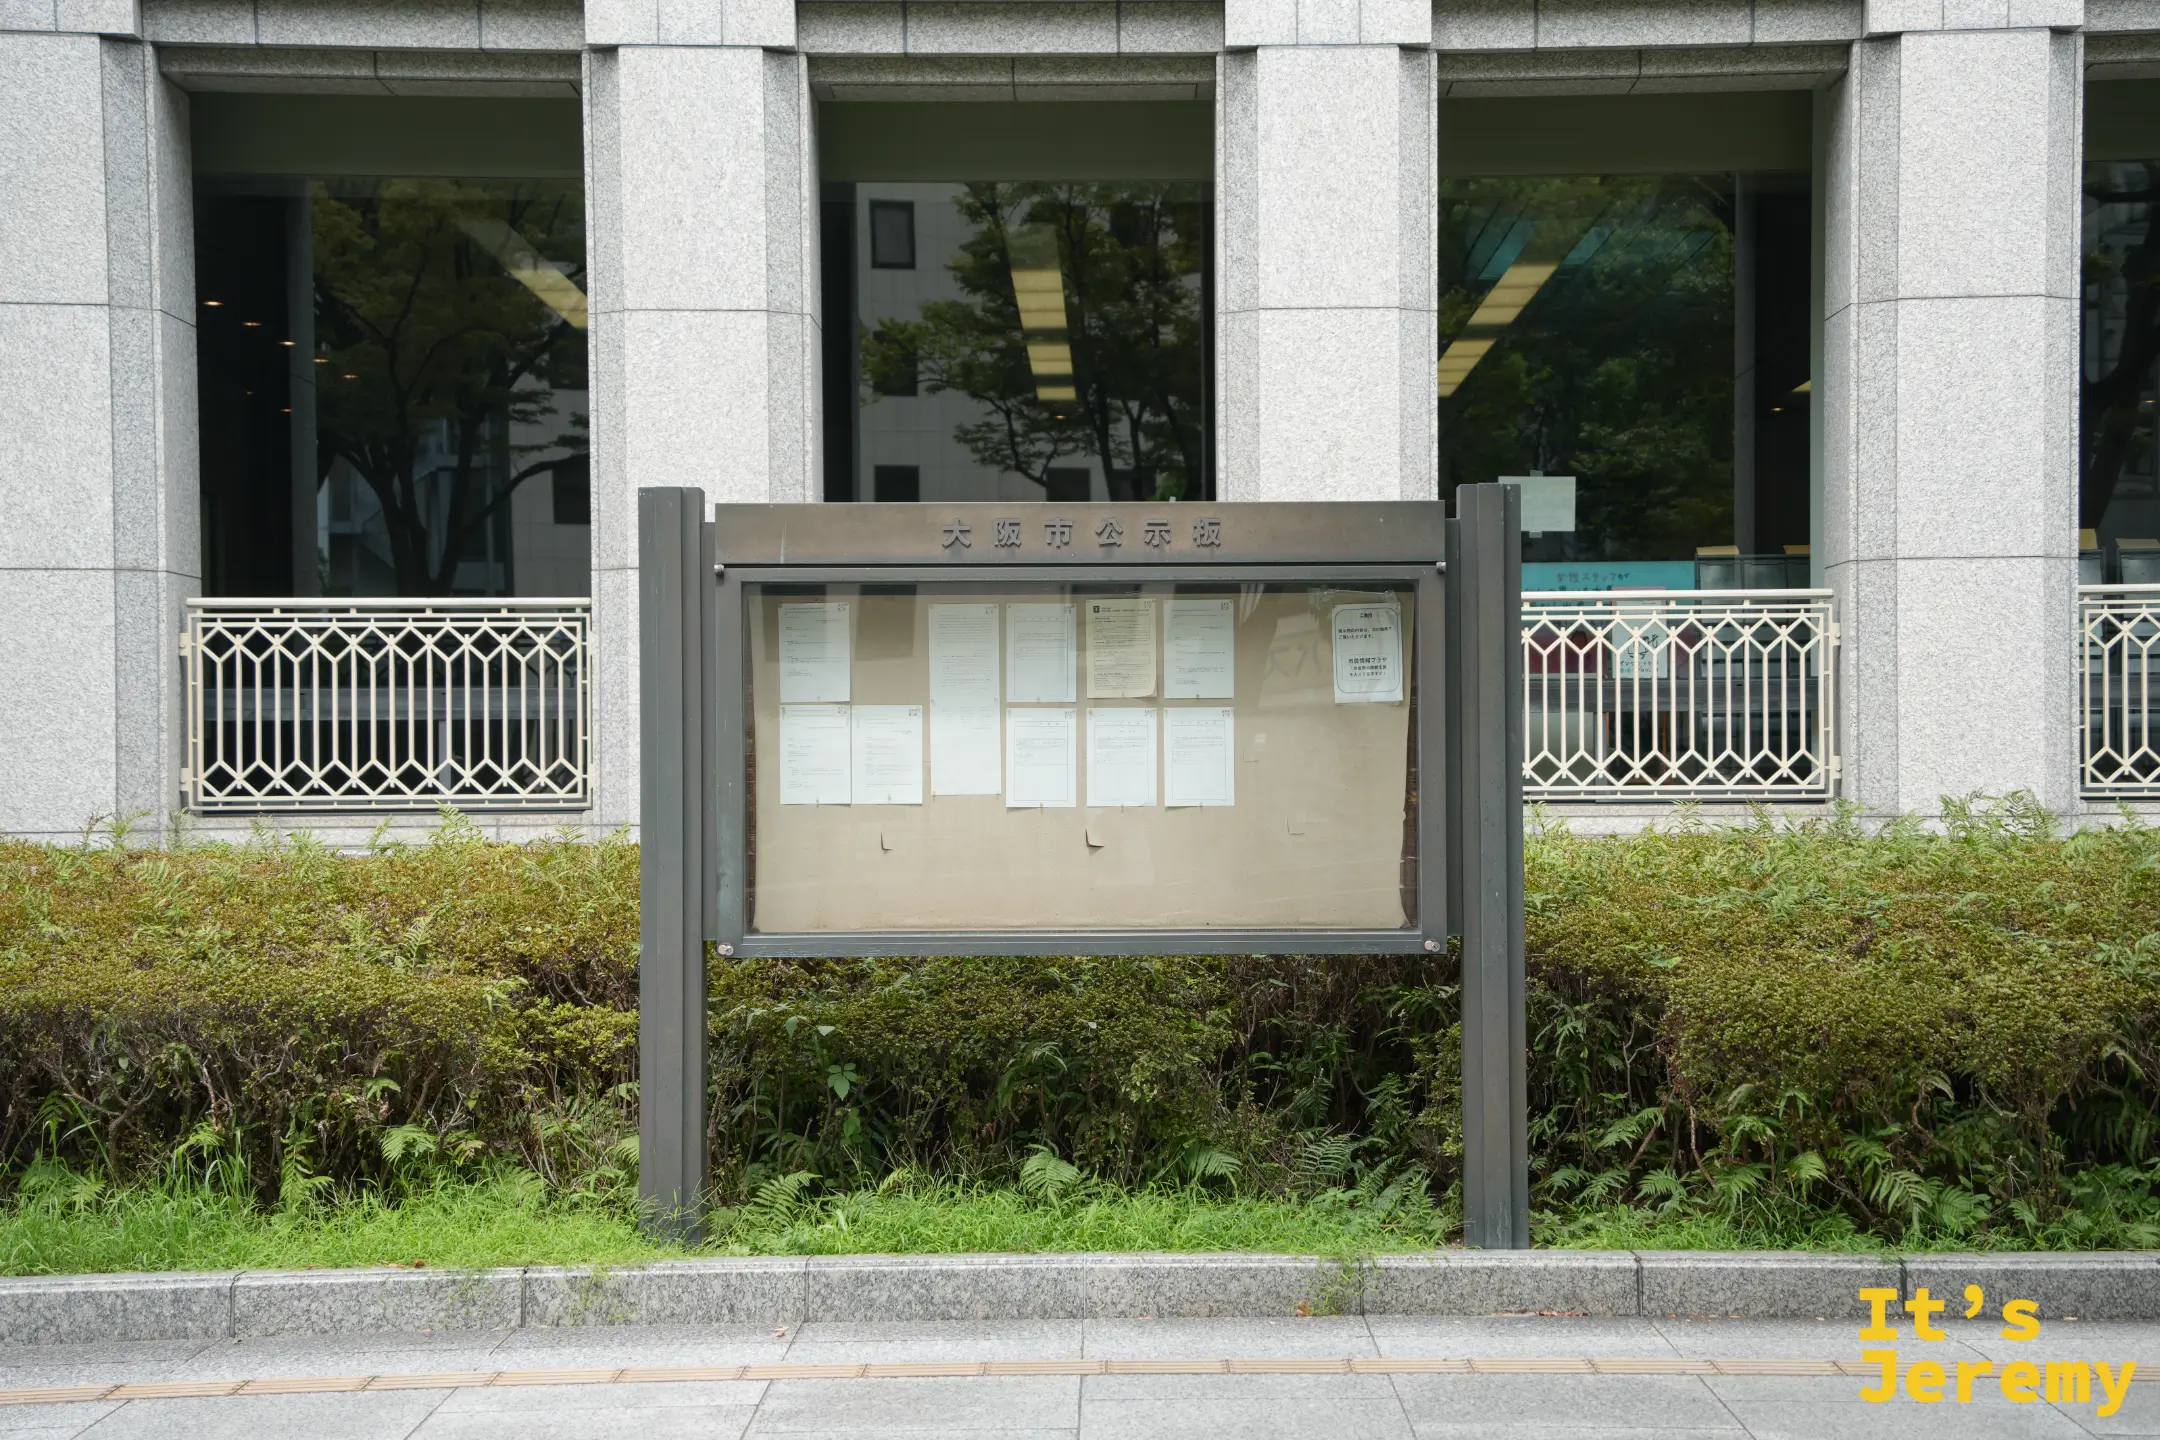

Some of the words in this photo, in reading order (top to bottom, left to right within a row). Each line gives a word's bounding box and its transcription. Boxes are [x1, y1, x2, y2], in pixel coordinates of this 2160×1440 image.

[942, 517, 1221, 548] 大阪市公示板
[1556, 571, 1630, 583] 女性スタッフが
[1348, 656, 1388, 664] 市民情報プラザ
